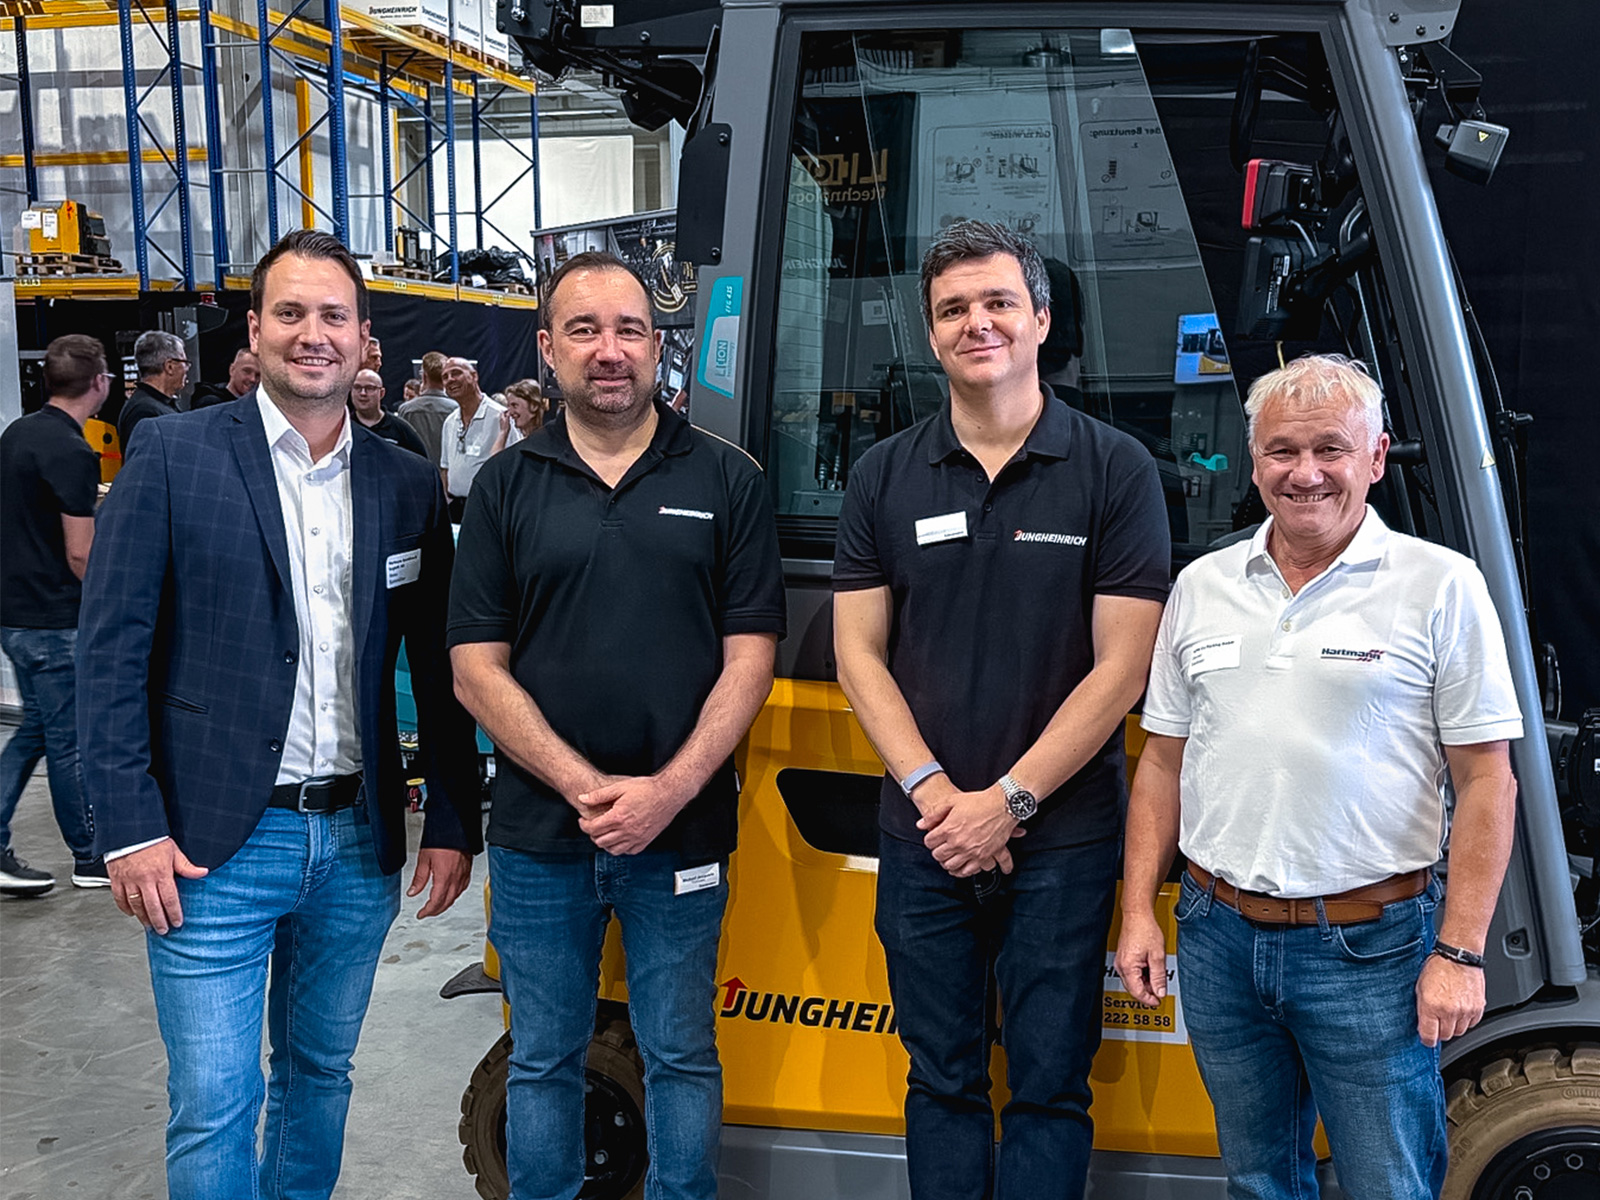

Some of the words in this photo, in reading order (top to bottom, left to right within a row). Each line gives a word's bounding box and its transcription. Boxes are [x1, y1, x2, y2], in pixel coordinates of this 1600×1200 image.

[1013, 529, 1087, 546] JUNGHEINRICH
[1321, 648, 1381, 660] Hartmann
[1104, 1012, 1129, 1024] 222
[1133, 1014, 1150, 1025] 58
[1154, 1015, 1171, 1027] 58
